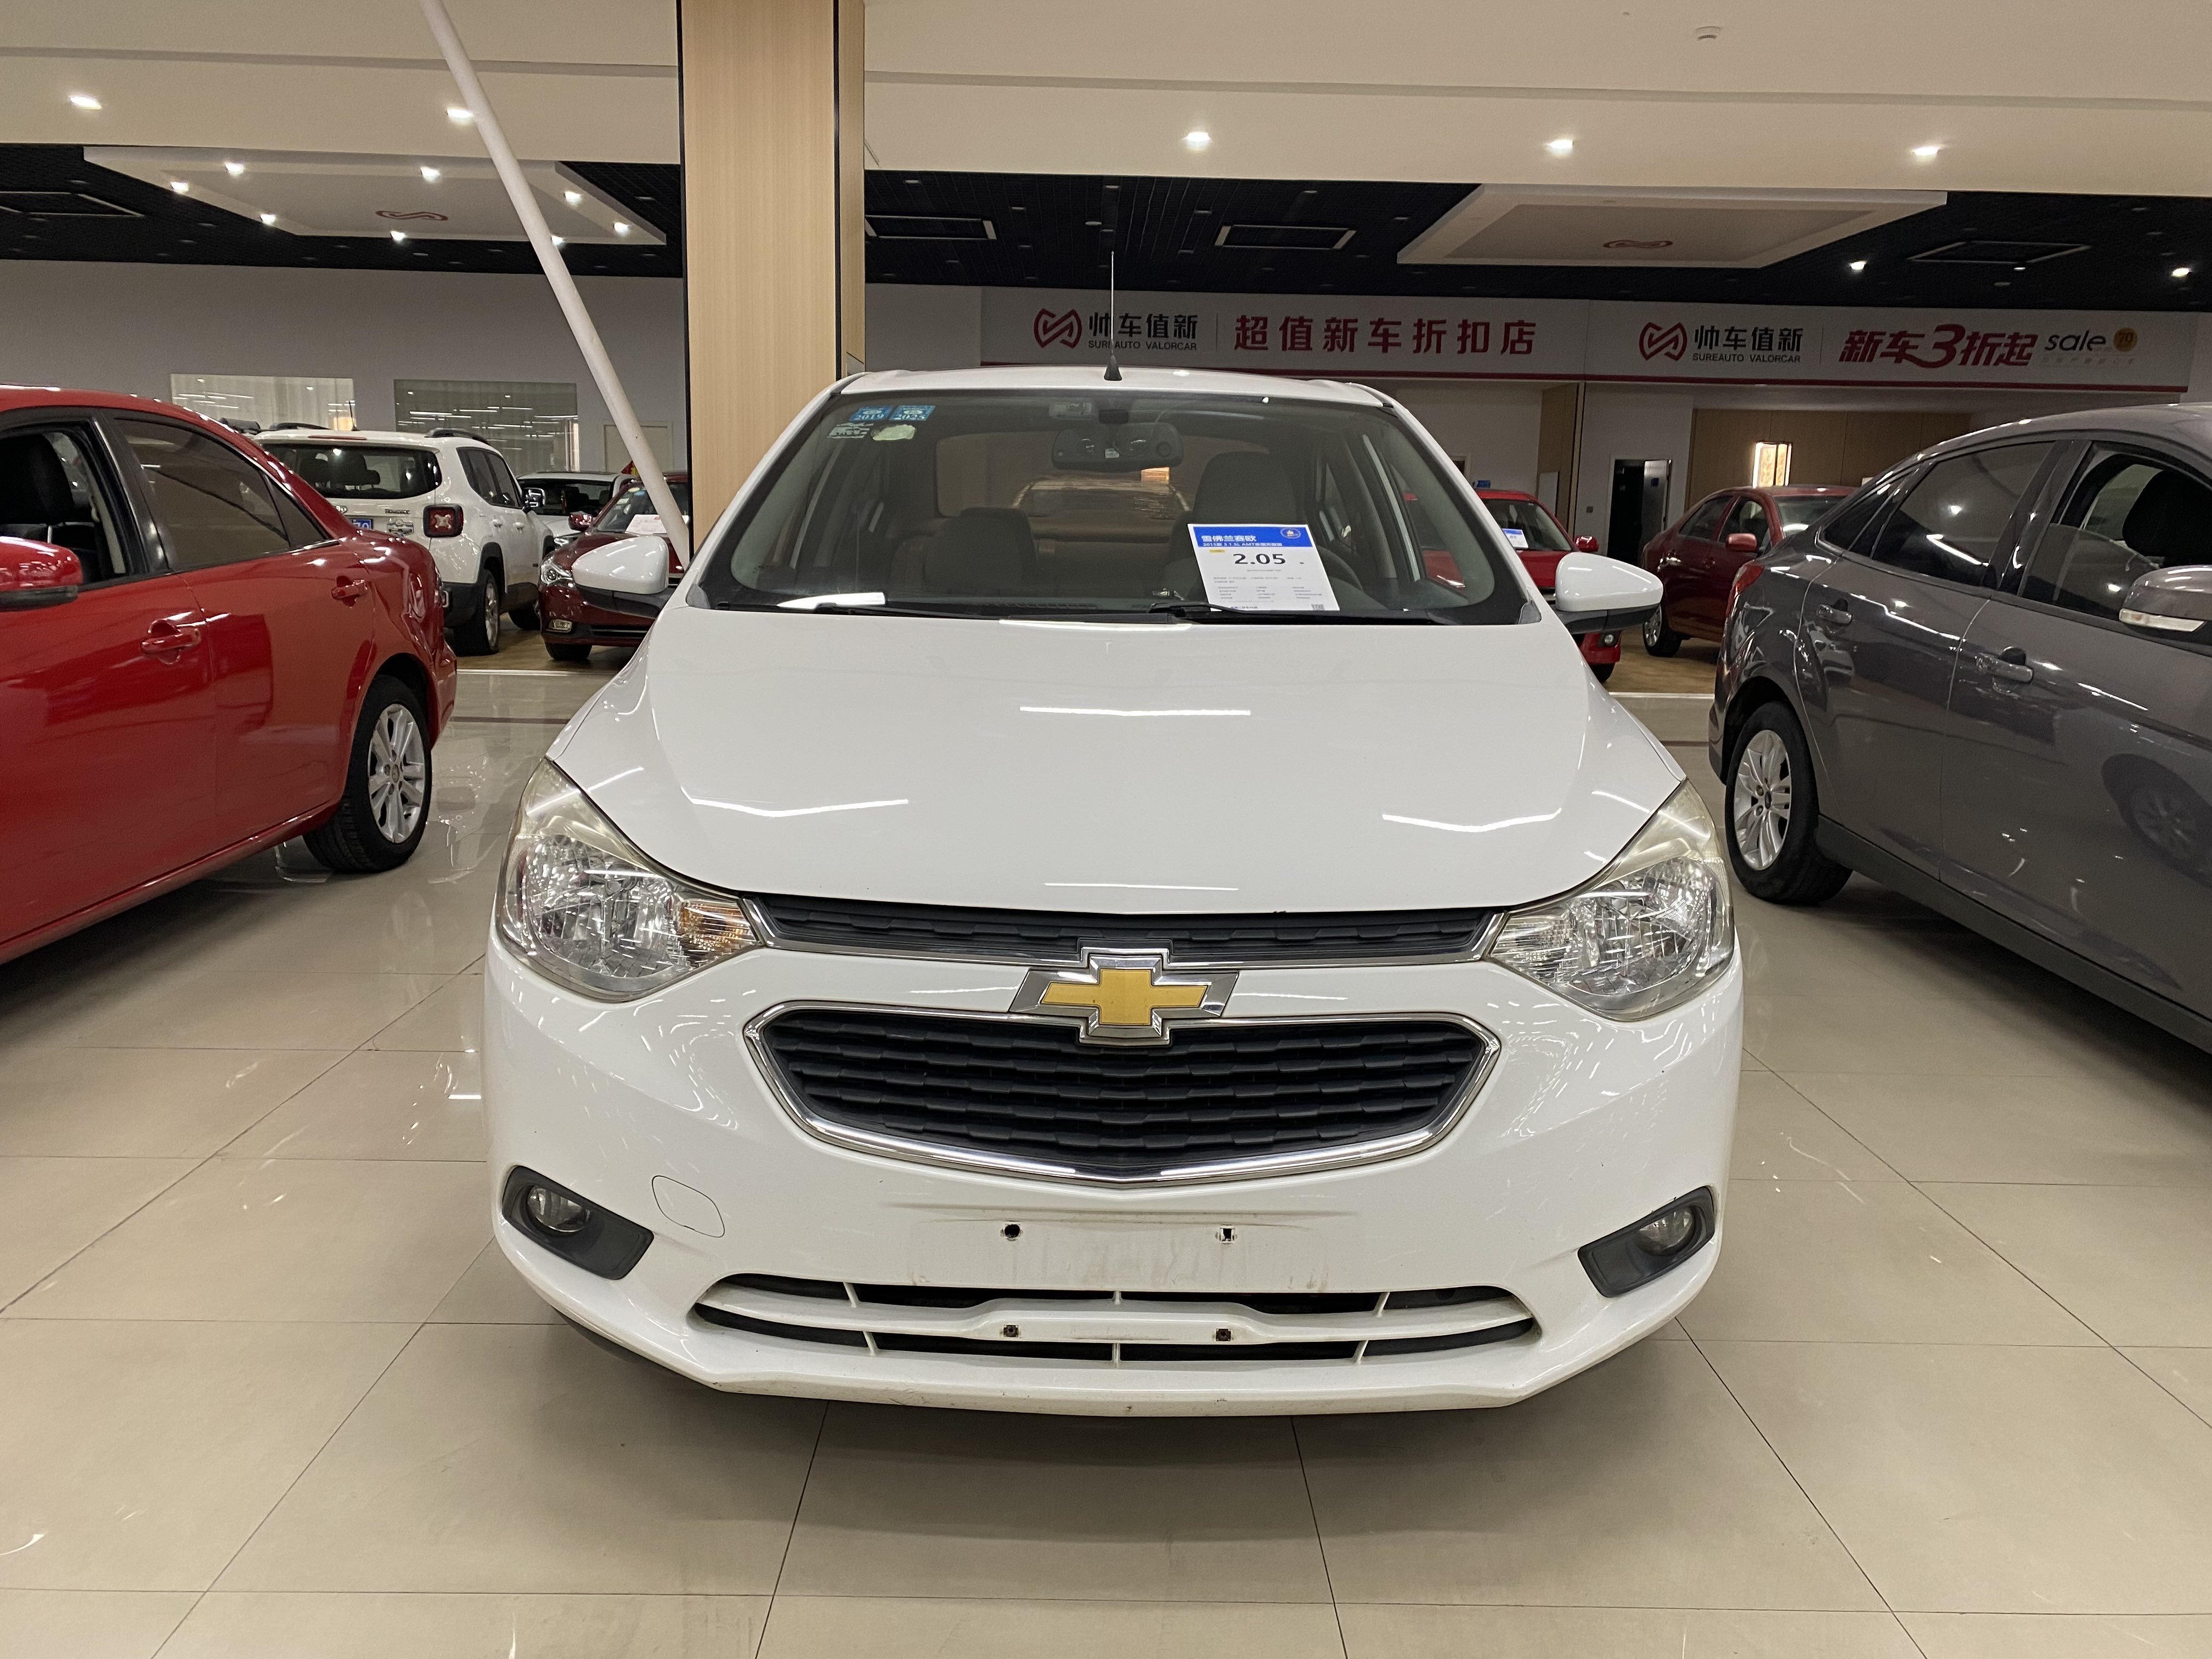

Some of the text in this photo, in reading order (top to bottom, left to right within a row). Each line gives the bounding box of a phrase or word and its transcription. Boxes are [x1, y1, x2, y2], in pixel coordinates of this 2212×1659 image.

[1089, 312, 1198, 339] 帅车值新
[1234, 314, 1536, 356] 超值新车折扣店
[1146, 342, 1197, 351] VALORCAR
[1694, 325, 1804, 352] 帅车值新
[1838, 324, 2039, 368] 新车3折起
[2045, 330, 2106, 351] sale
[1692, 353, 1801, 363] SUREAUTO VALORCAR
[1233, 554, 1286, 565] 2.05
